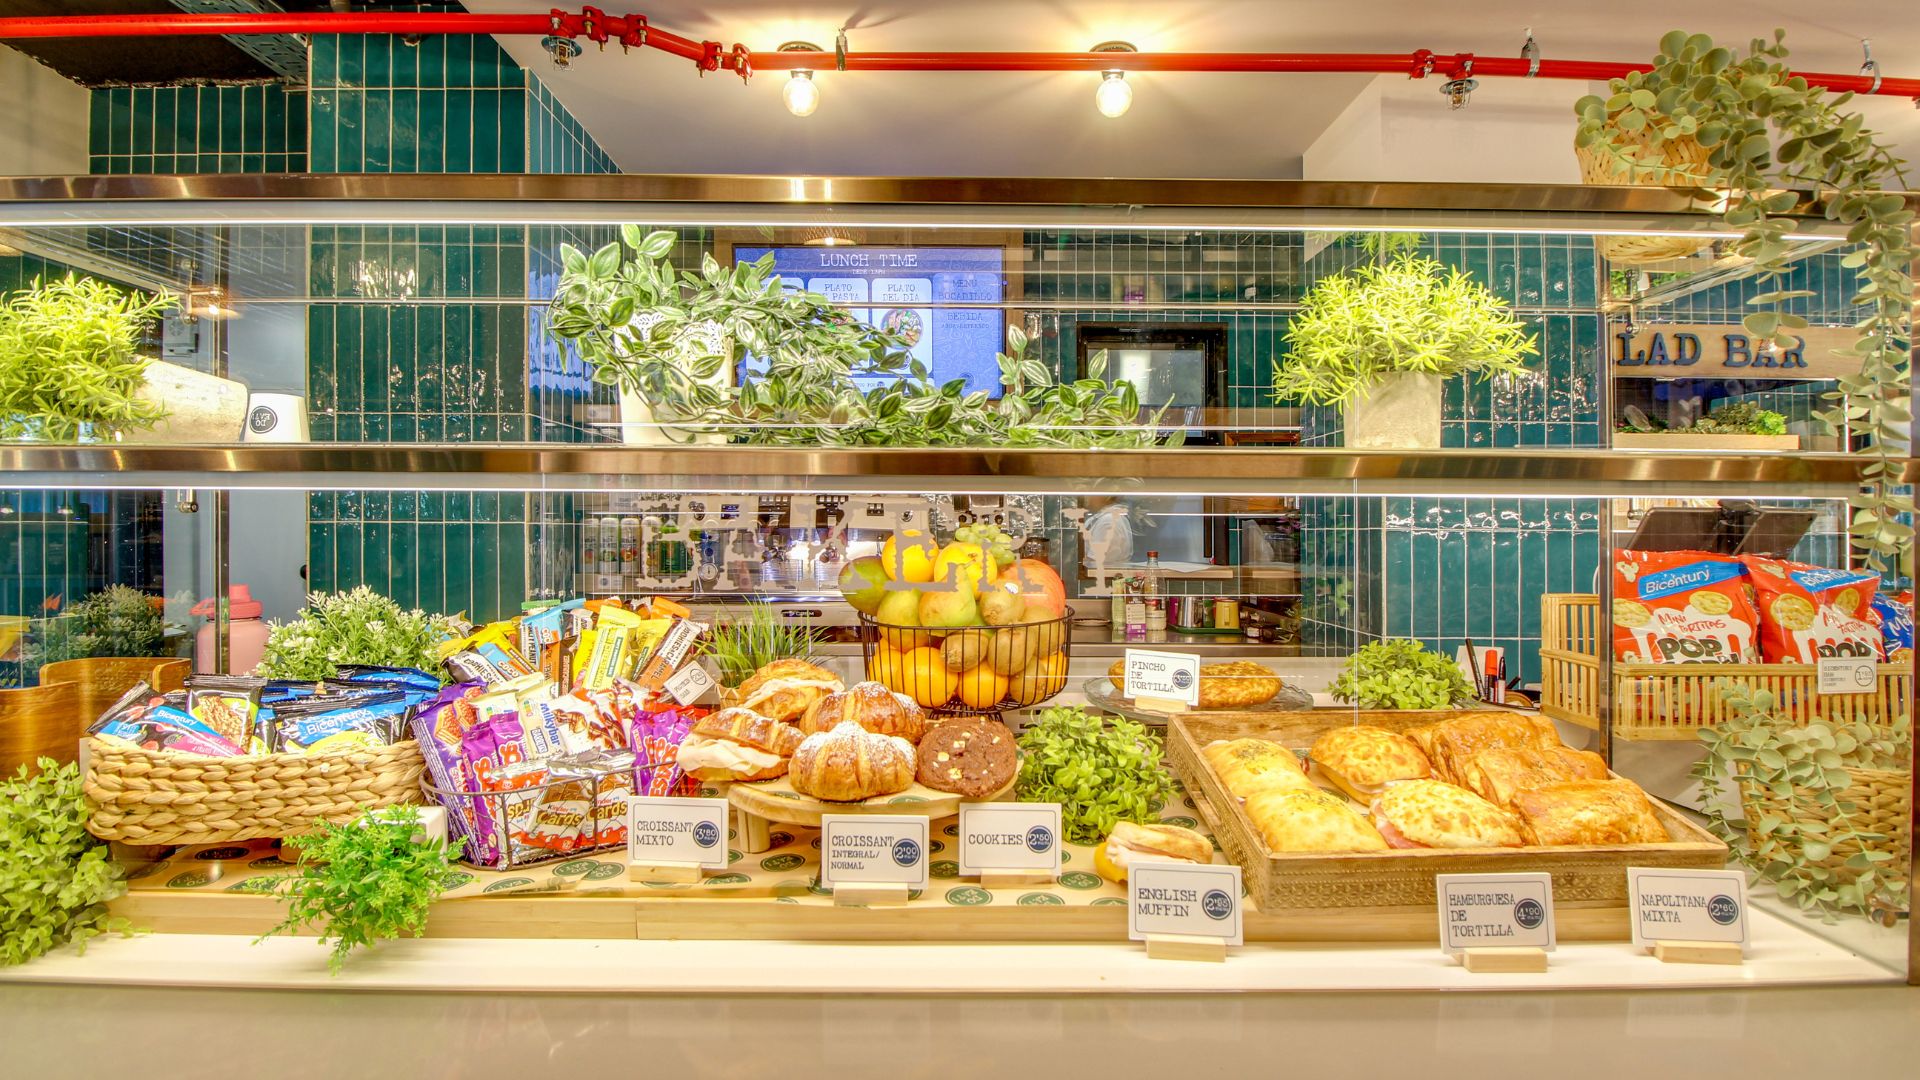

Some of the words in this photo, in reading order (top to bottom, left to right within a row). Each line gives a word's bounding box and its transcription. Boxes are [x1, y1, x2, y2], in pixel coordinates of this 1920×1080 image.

[820, 253, 869, 267] LUNCH
[879, 254, 918, 267] TIME
[824, 283, 853, 293] PLATO
[887, 284, 916, 293] PLATO
[952, 279, 978, 288] MENU
[832, 293, 860, 302] PASTA
[883, 293, 900, 302] DEL
[903, 293, 920, 302] DIA
[947, 312, 983, 321] BEBIDA
[1616, 332, 1702, 367] LAD
[1723, 334, 1808, 369] BAR
[1646, 568, 1710, 594] Bicentury
[1656, 636, 1723, 660] POP
[497, 659, 519, 678] COCO
[1131, 661, 1166, 671] PINCHO
[1131, 671, 1143, 680] DE
[1131, 680, 1175, 693] TORTILLA
[157, 710, 198, 726] Bicentury
[306, 709, 369, 735] Bicentury
[540, 703, 561, 746] Milkybar
[586, 800, 628, 821] Cards
[537, 812, 583, 826] Cards
[637, 820, 693, 832] CROISSANT
[636, 835, 674, 846] MIXTO
[696, 828, 717, 840] 3'80
[968, 833, 1023, 845] COOKIES
[1029, 833, 1050, 845] 2'50
[832, 835, 894, 847] CROISSANT
[832, 850, 880, 859] INTEGRAL/
[895, 846, 917, 859] 2'00
[831, 861, 865, 870] NORMAL
[1138, 887, 1197, 902] ENGLISH
[1449, 893, 1516, 906] HAMBURGUESA
[1641, 894, 1708, 908] NAPOLITANA
[1138, 903, 1190, 917] MUFFIN
[1450, 910, 1467, 922] DE
[1518, 907, 1540, 920] 4'90
[1642, 910, 1681, 923] MIXTA
[1452, 924, 1515, 937] TORTILLA
